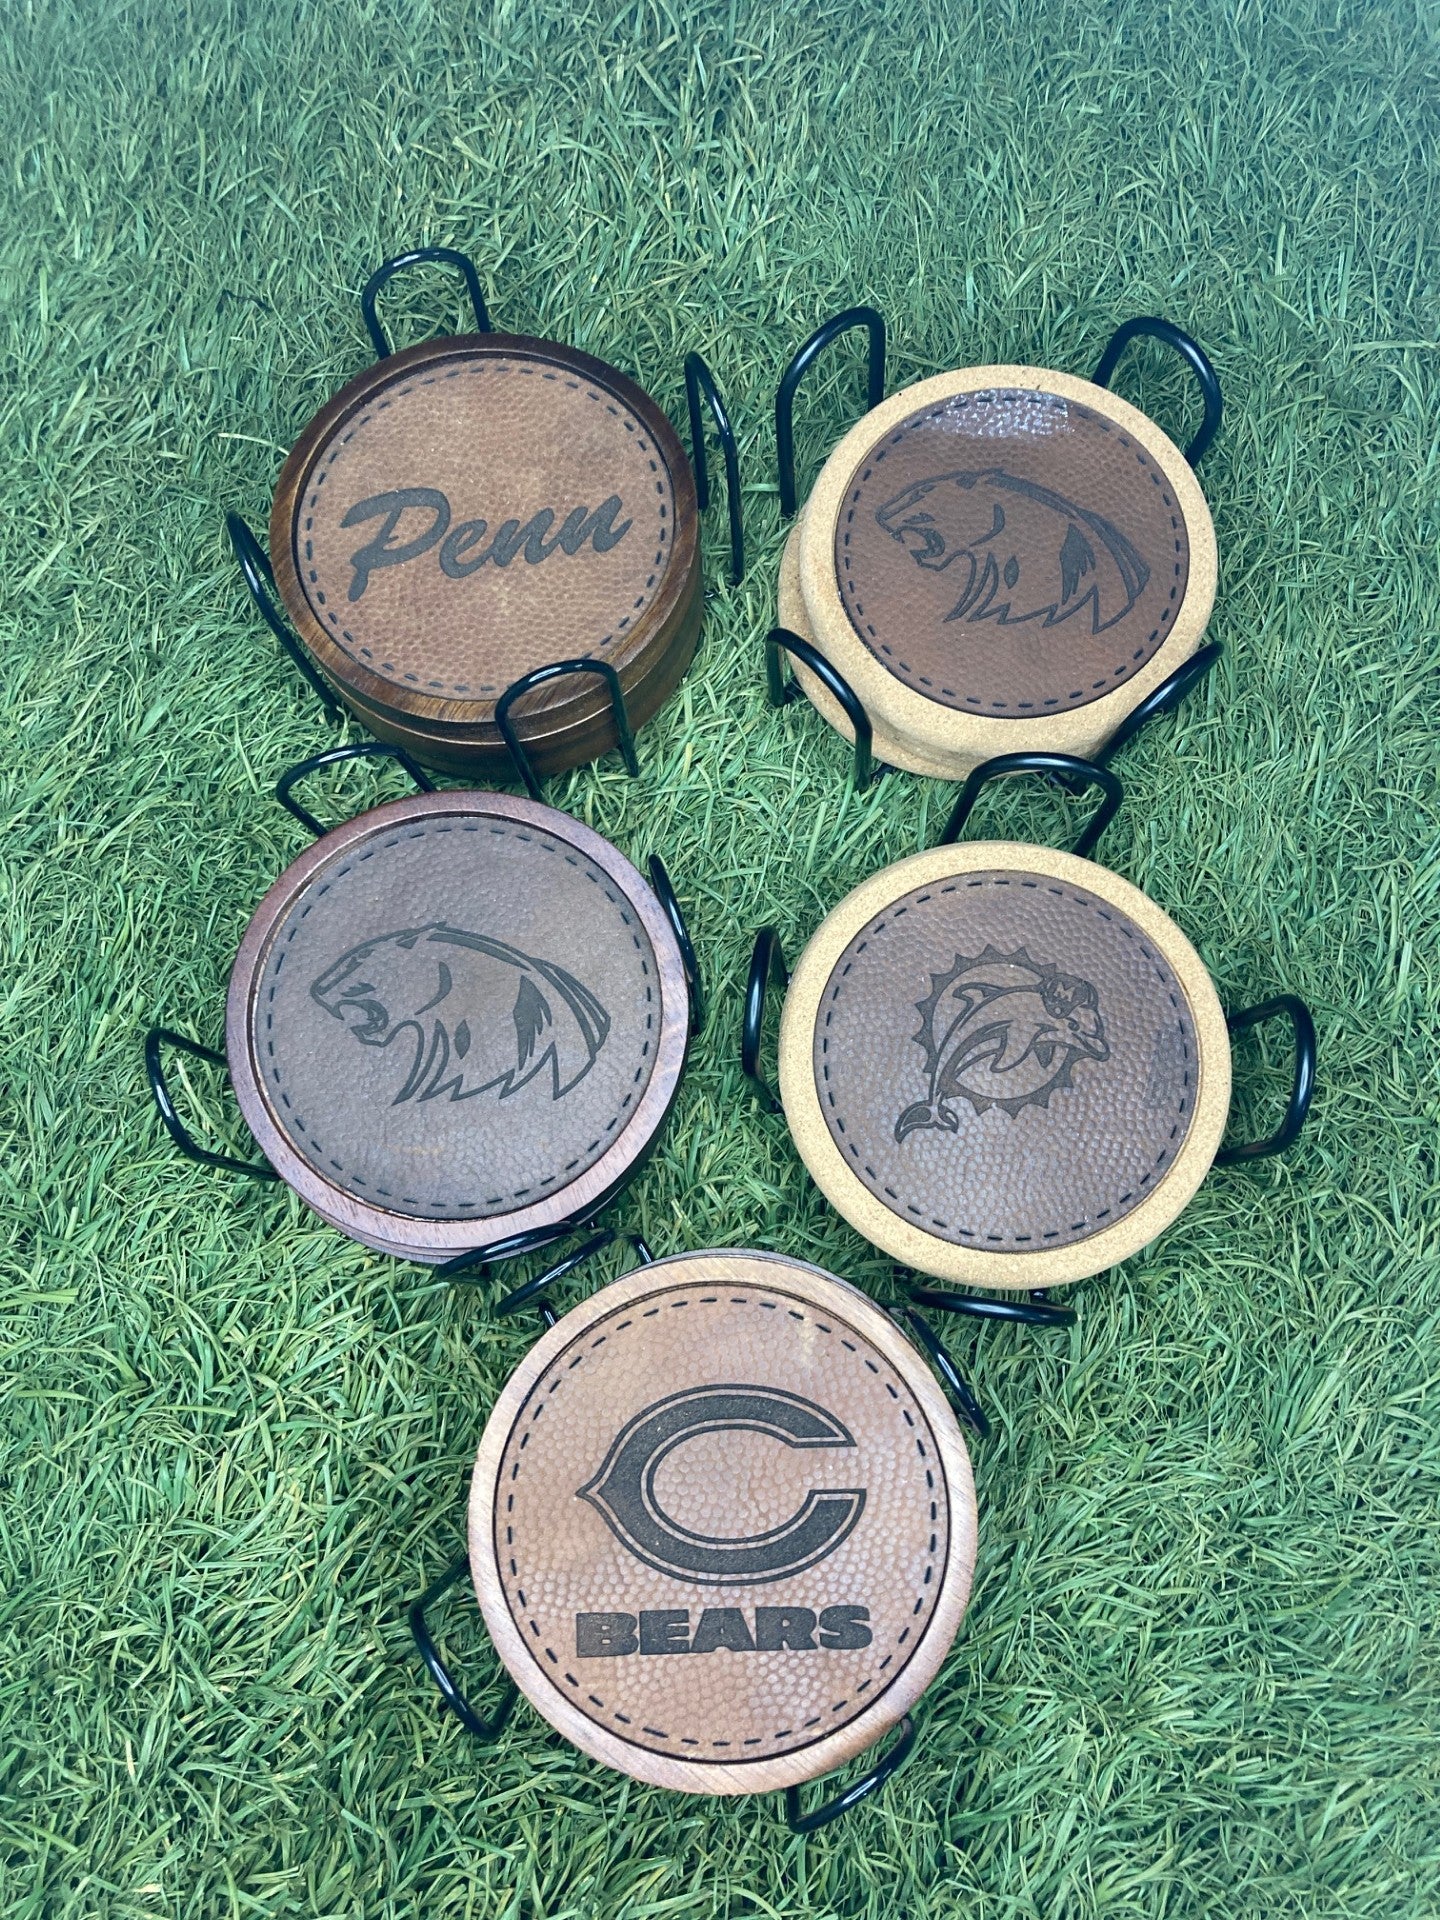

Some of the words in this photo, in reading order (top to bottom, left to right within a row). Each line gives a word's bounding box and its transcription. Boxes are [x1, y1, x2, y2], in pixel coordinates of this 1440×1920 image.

[340, 487, 632, 602] Penn
[1053, 981, 1076, 1002] M
[575, 1384, 867, 1586] C
[576, 1605, 873, 1658] BEARS
